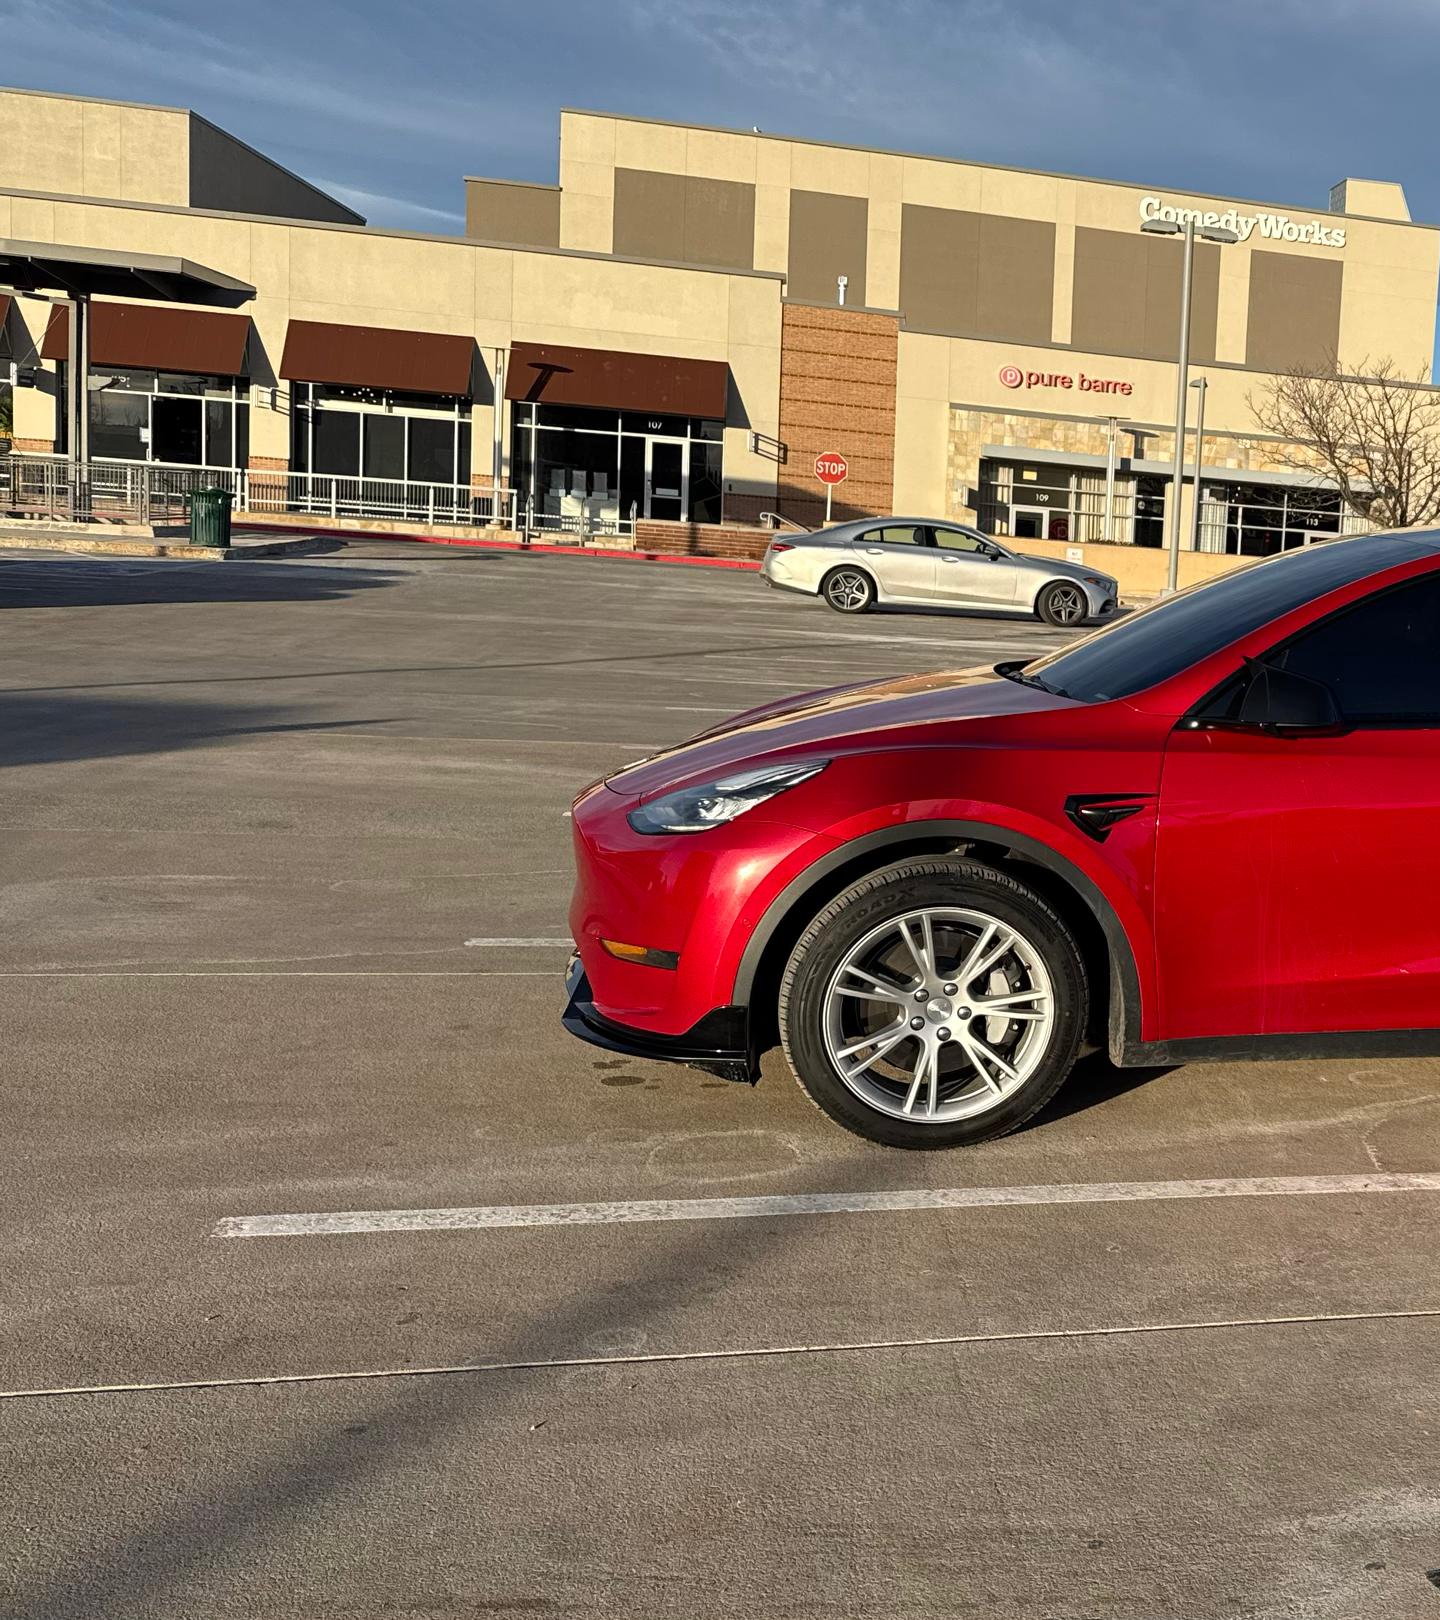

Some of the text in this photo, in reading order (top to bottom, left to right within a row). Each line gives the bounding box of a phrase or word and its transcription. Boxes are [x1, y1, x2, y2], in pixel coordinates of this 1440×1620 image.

[1026, 371, 1073, 389] pure
[1079, 373, 1133, 396] barre
[817, 461, 846, 475] STOP
[1035, 493, 1049, 502] 109
[1306, 518, 1319, 526] 113
